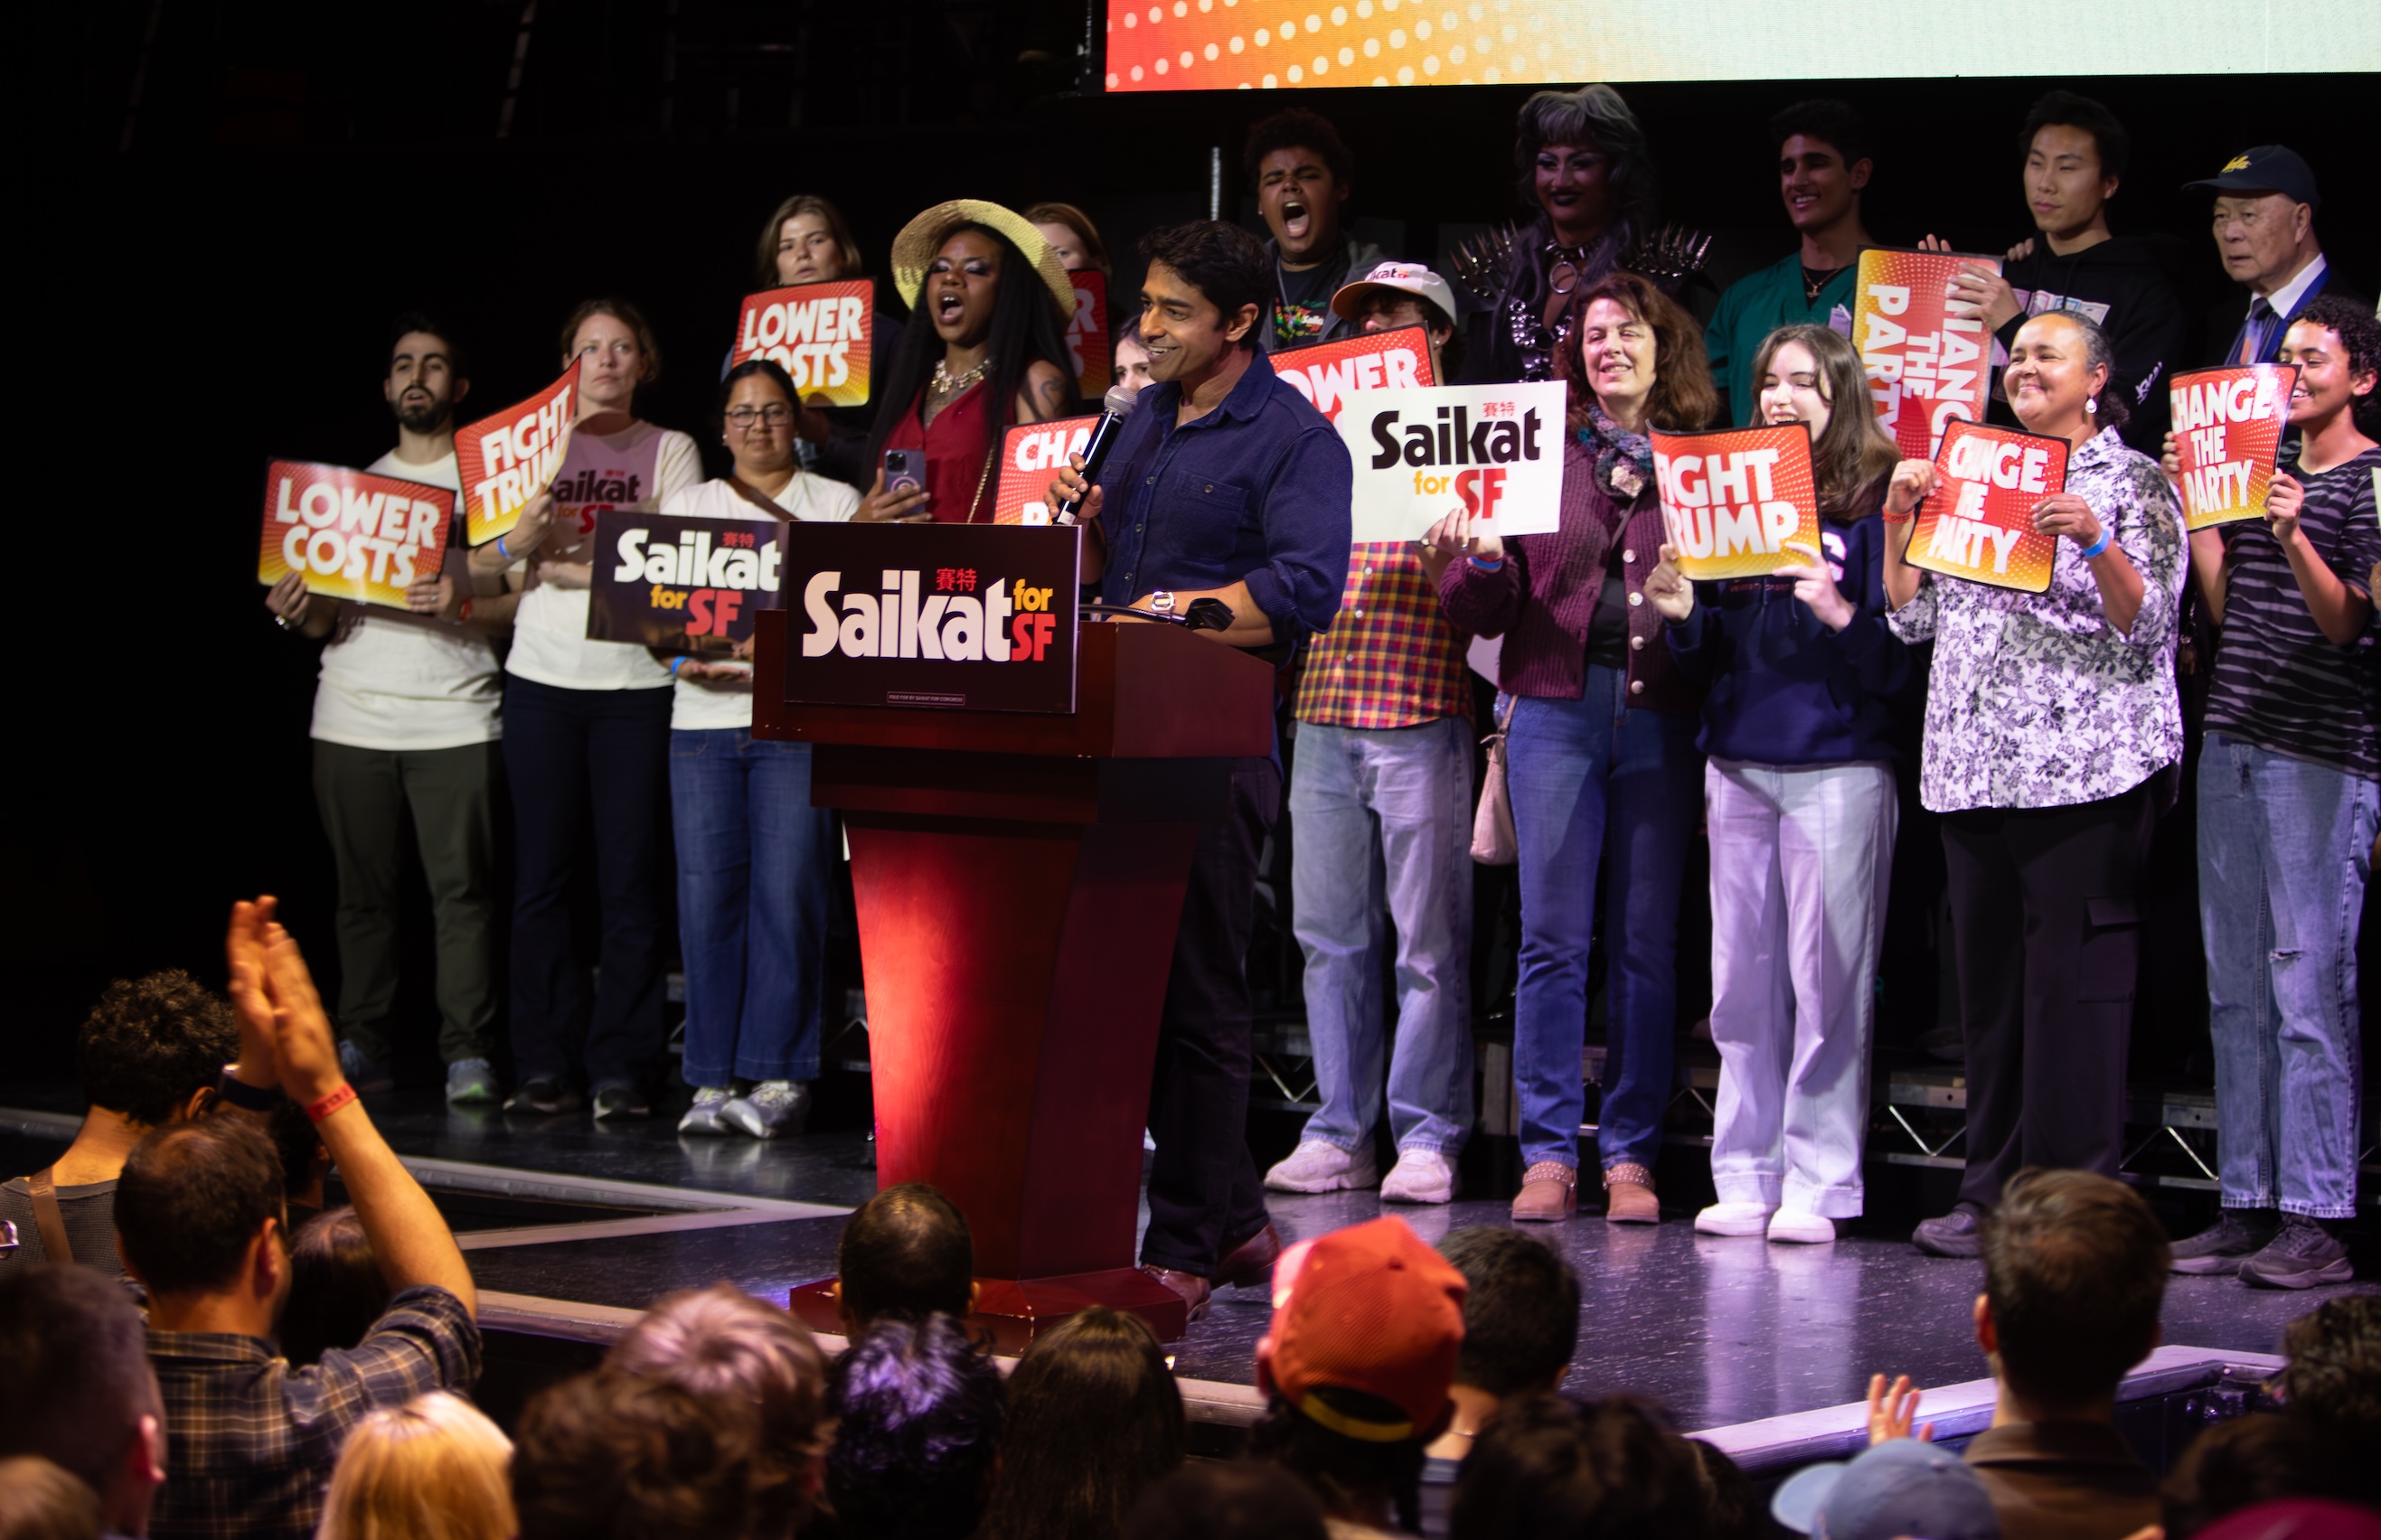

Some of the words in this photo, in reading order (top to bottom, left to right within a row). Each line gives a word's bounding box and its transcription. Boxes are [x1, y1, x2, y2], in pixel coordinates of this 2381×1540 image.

[740, 296, 864, 352] LOWER
[1275, 348, 1422, 413] OWER
[1902, 331, 1941, 399] THE
[480, 384, 571, 478] FIGHT
[1015, 427, 1092, 472] CHA
[1371, 406, 1541, 470] Saikat
[2190, 426, 2227, 467] THE
[275, 477, 441, 549] LOWER
[553, 470, 640, 503] aikat
[1414, 470, 1450, 494] for
[1454, 468, 1507, 521] SF
[2184, 459, 2254, 517] PARTY
[282, 524, 419, 588] COSTS
[614, 528, 782, 592] Saikat
[936, 568, 977, 592] 賽特
[650, 585, 688, 610] for
[685, 588, 743, 637] SF
[803, 569, 1012, 662] Saikat
[1013, 578, 1054, 612] for
[1011, 614, 1057, 662] SF
